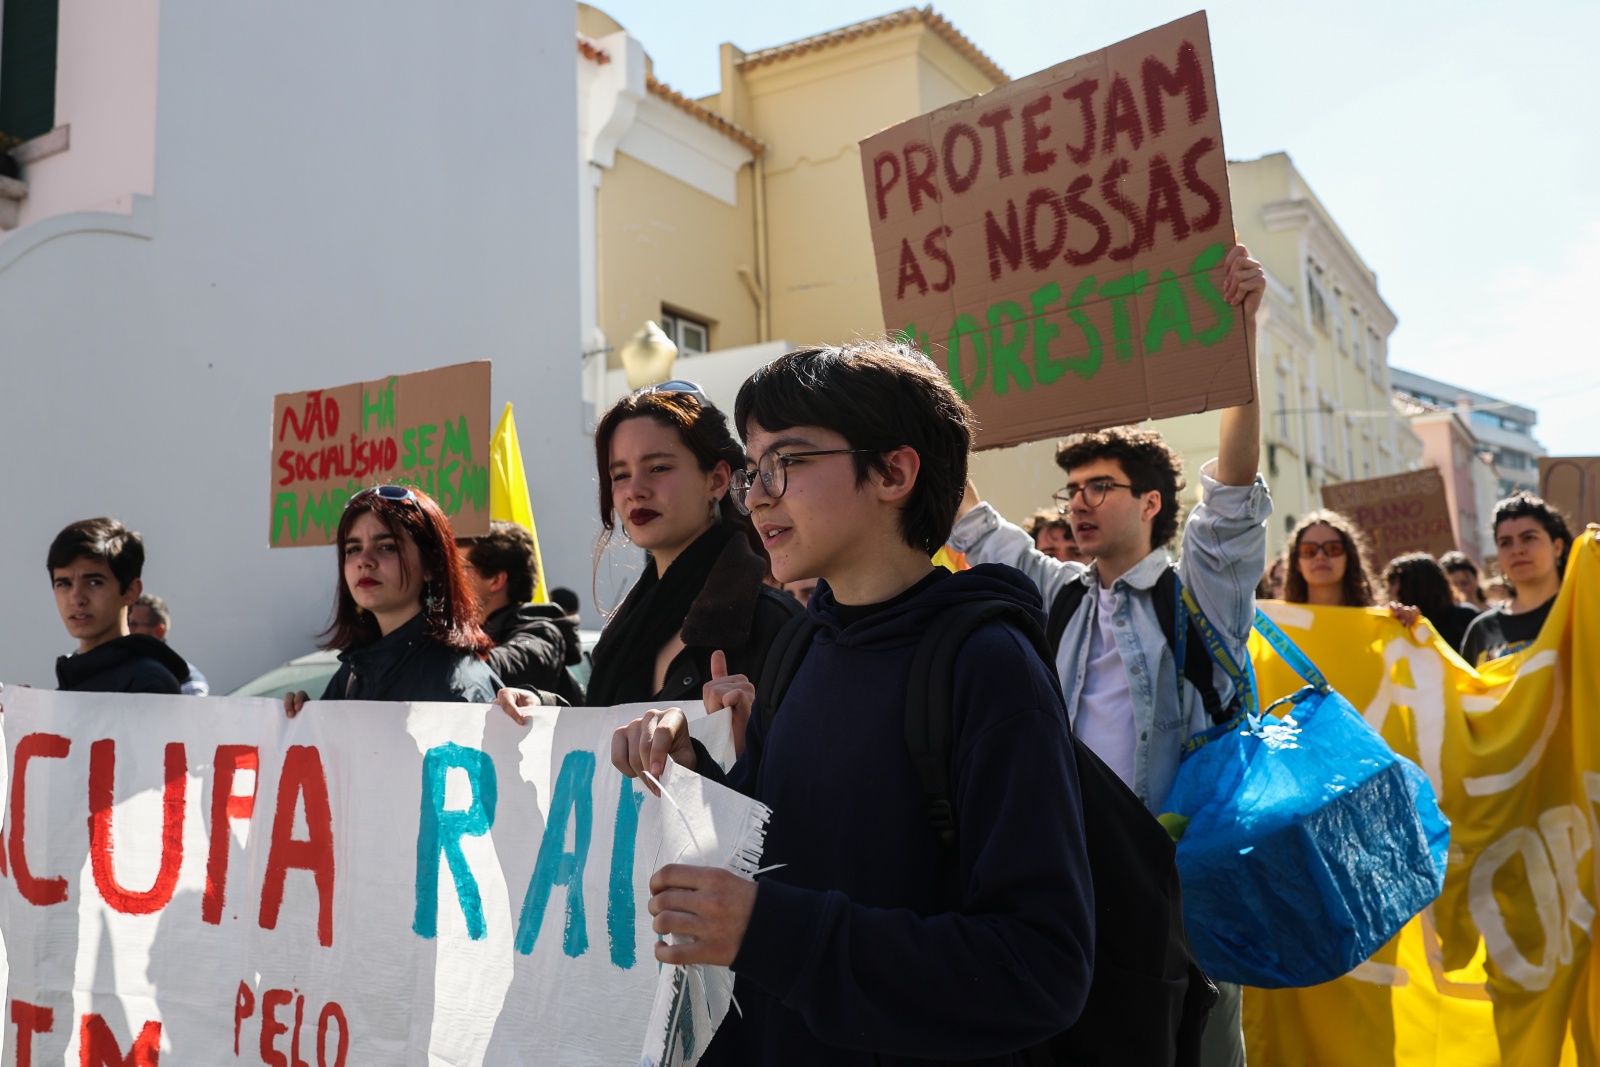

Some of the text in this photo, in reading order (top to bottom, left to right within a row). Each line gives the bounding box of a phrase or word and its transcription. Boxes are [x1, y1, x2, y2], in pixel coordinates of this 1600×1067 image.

[873, 40, 1209, 221] PROTEJAM
[897, 137, 1221, 299] AS NOSSAS
[896, 242, 1236, 400] ORESTAS
[279, 376, 397, 443] NÃO HÁ
[402, 414, 472, 470] SEM
[1356, 500, 1424, 528] PLANO
[0, 732, 334, 947] CUPA
[234, 979, 349, 1067] PELO
